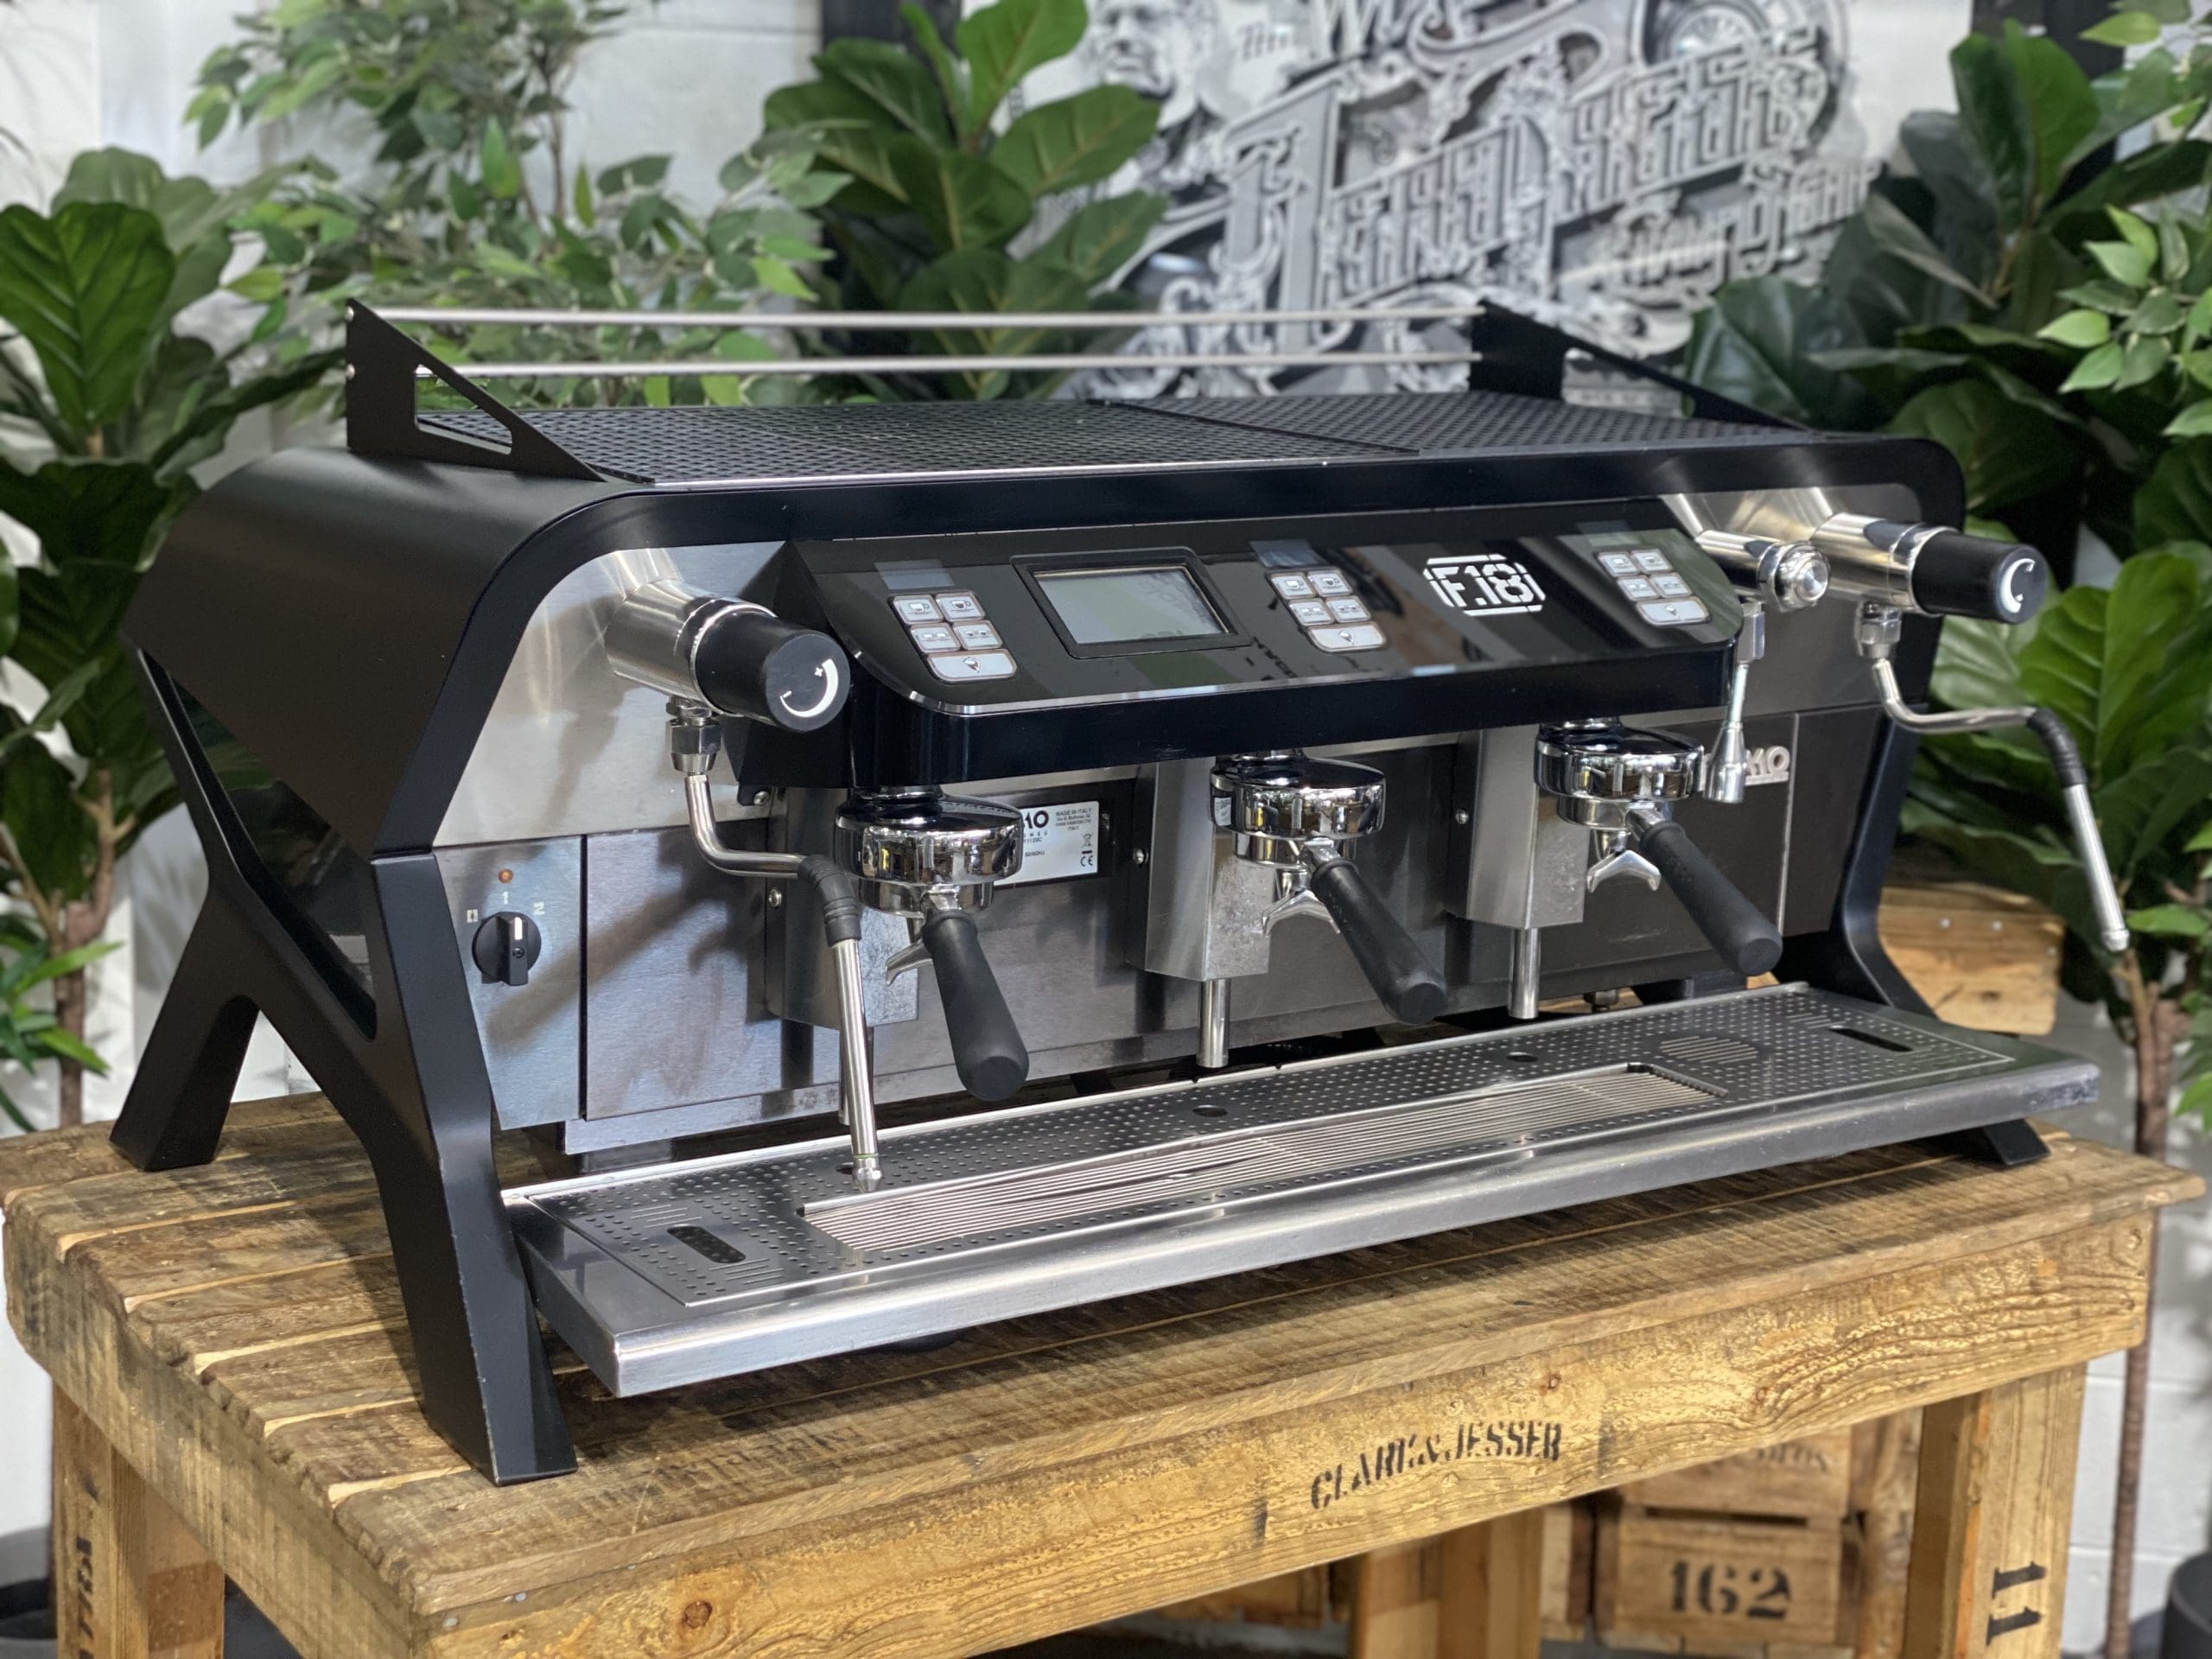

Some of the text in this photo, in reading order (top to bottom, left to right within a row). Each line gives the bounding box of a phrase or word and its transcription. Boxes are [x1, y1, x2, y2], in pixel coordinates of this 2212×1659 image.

[501, 891, 509, 905] 1
[533, 901, 545, 915] 2
[1669, 1560, 1793, 1620] 162
